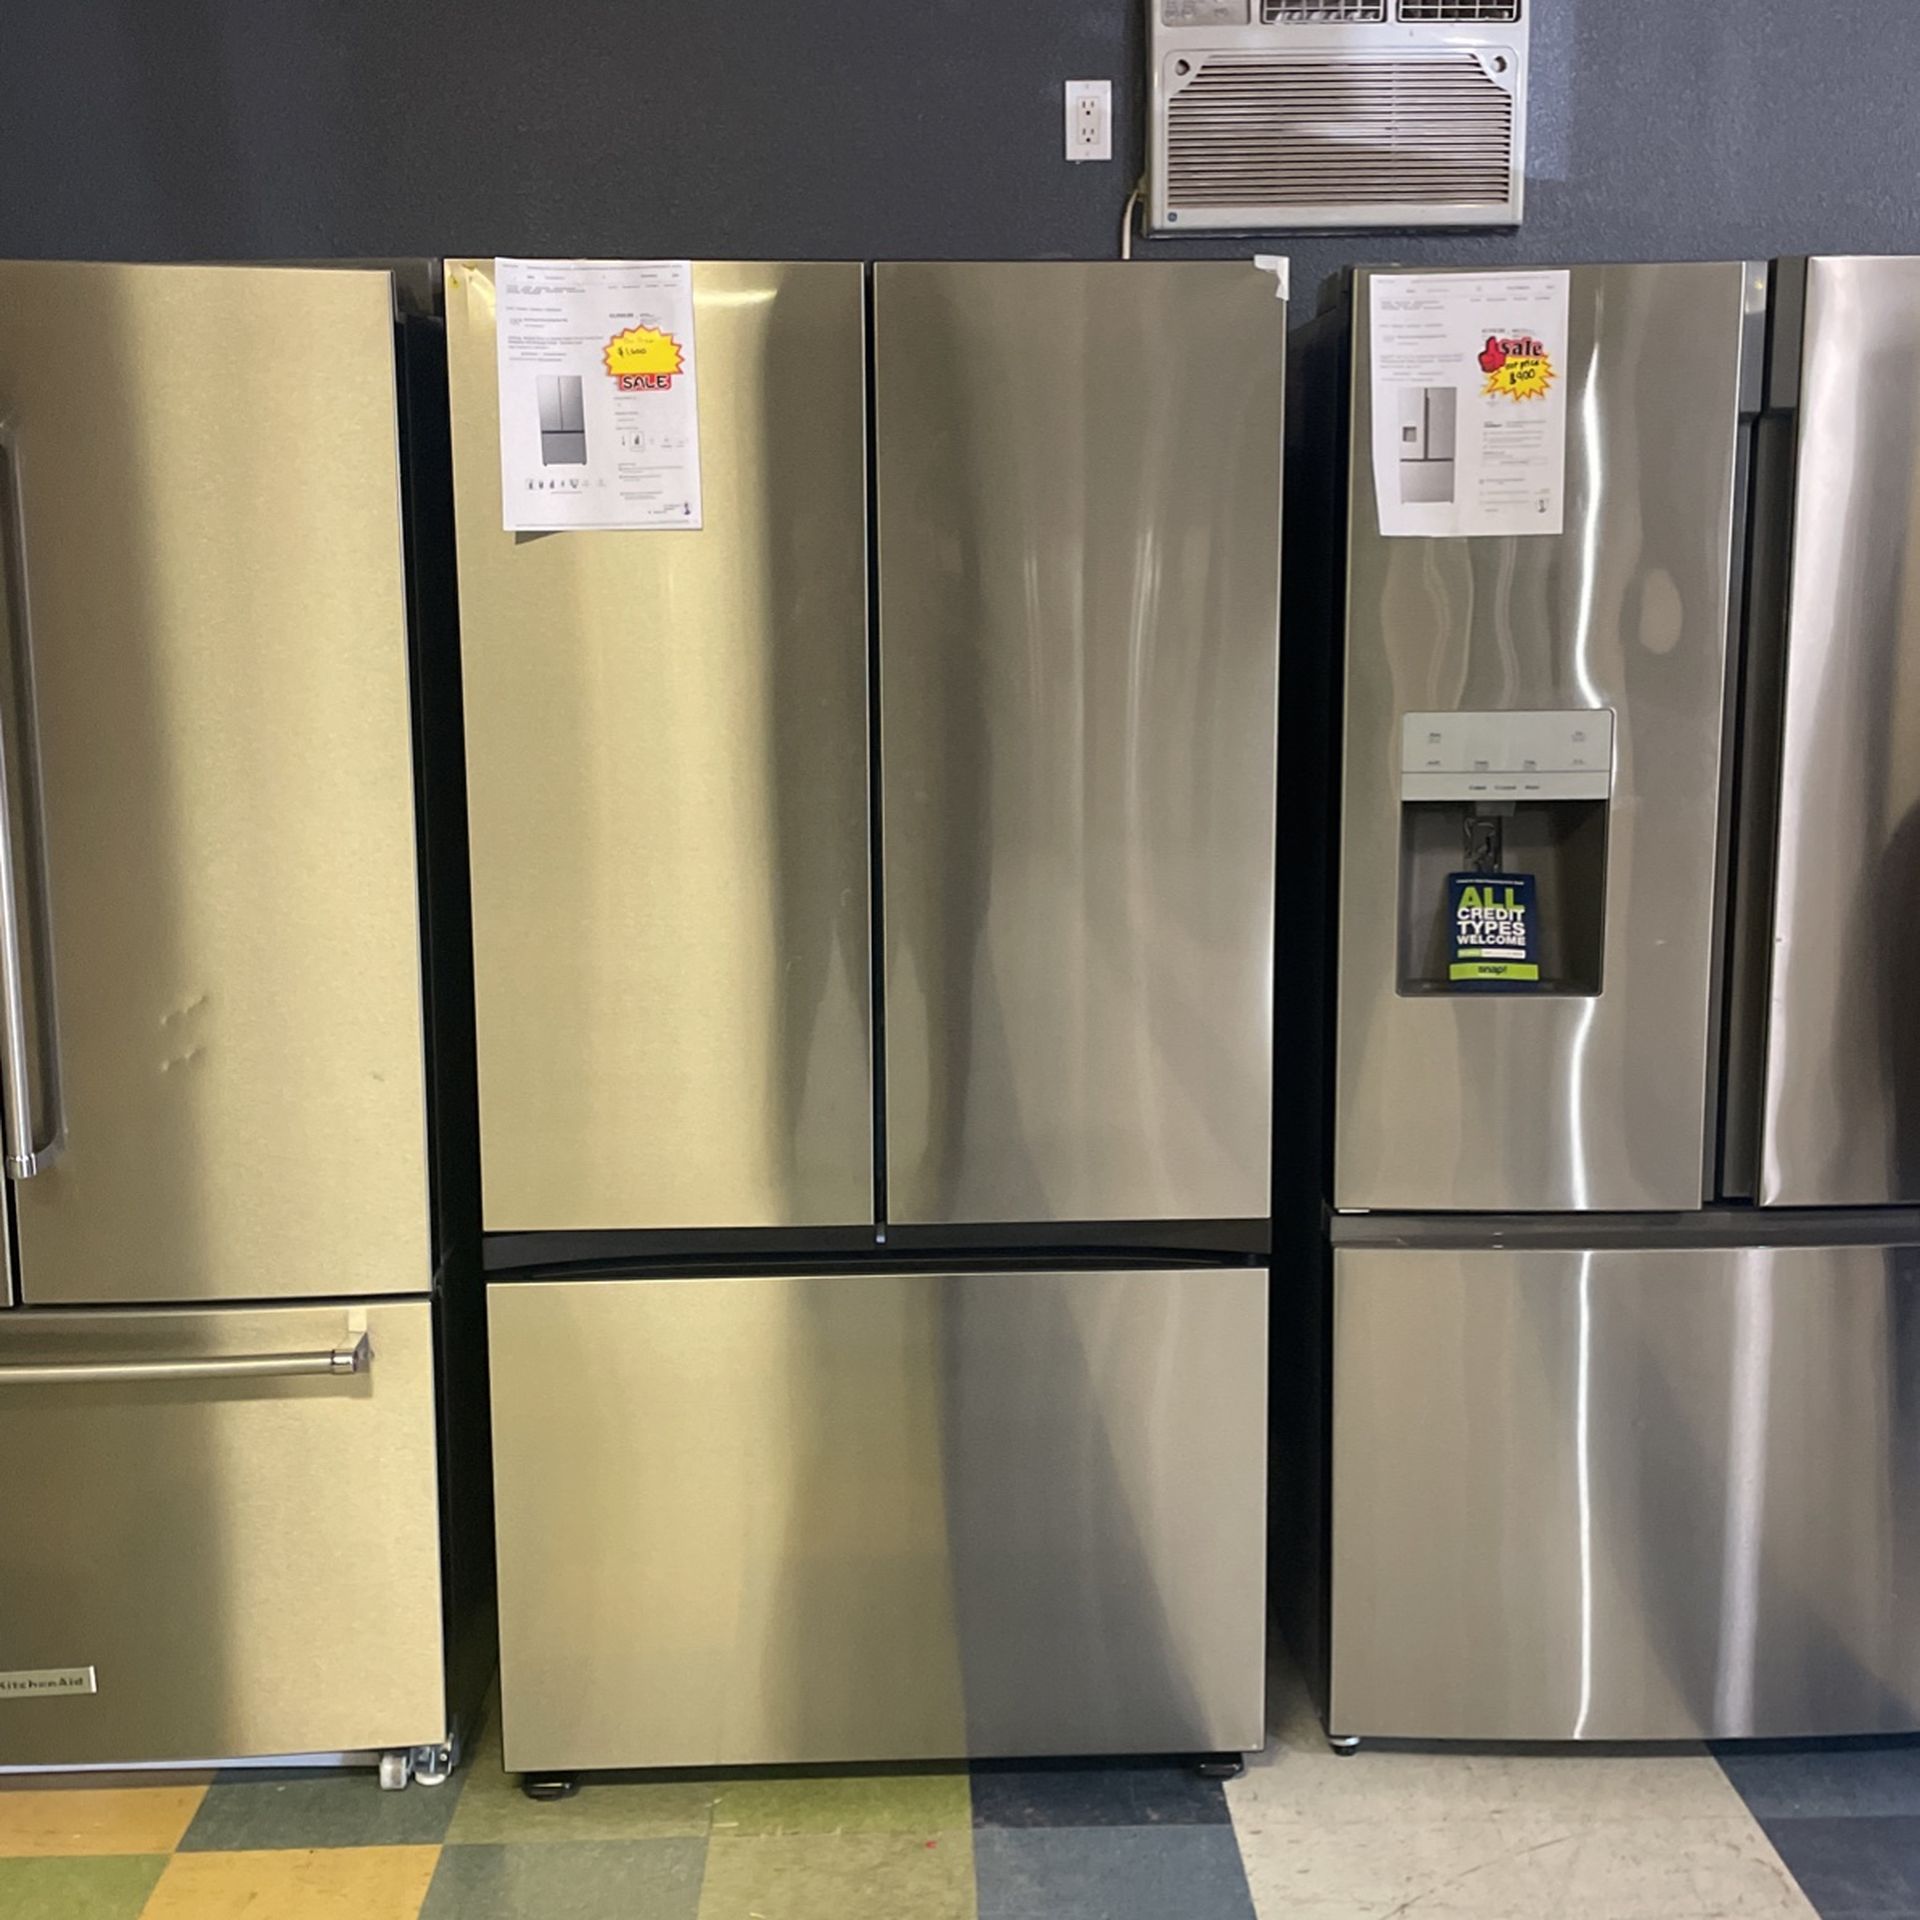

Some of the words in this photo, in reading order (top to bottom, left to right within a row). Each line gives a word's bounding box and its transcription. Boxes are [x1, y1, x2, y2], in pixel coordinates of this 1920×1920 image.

[1501, 340, 1543, 356] sale
[623, 375, 667, 389] SALE
[1458, 886, 1525, 909] ALL
[1457, 907, 1525, 921] CREDIT
[1457, 921, 1525, 935] TYPES
[1456, 935, 1526, 946] WELCOME
